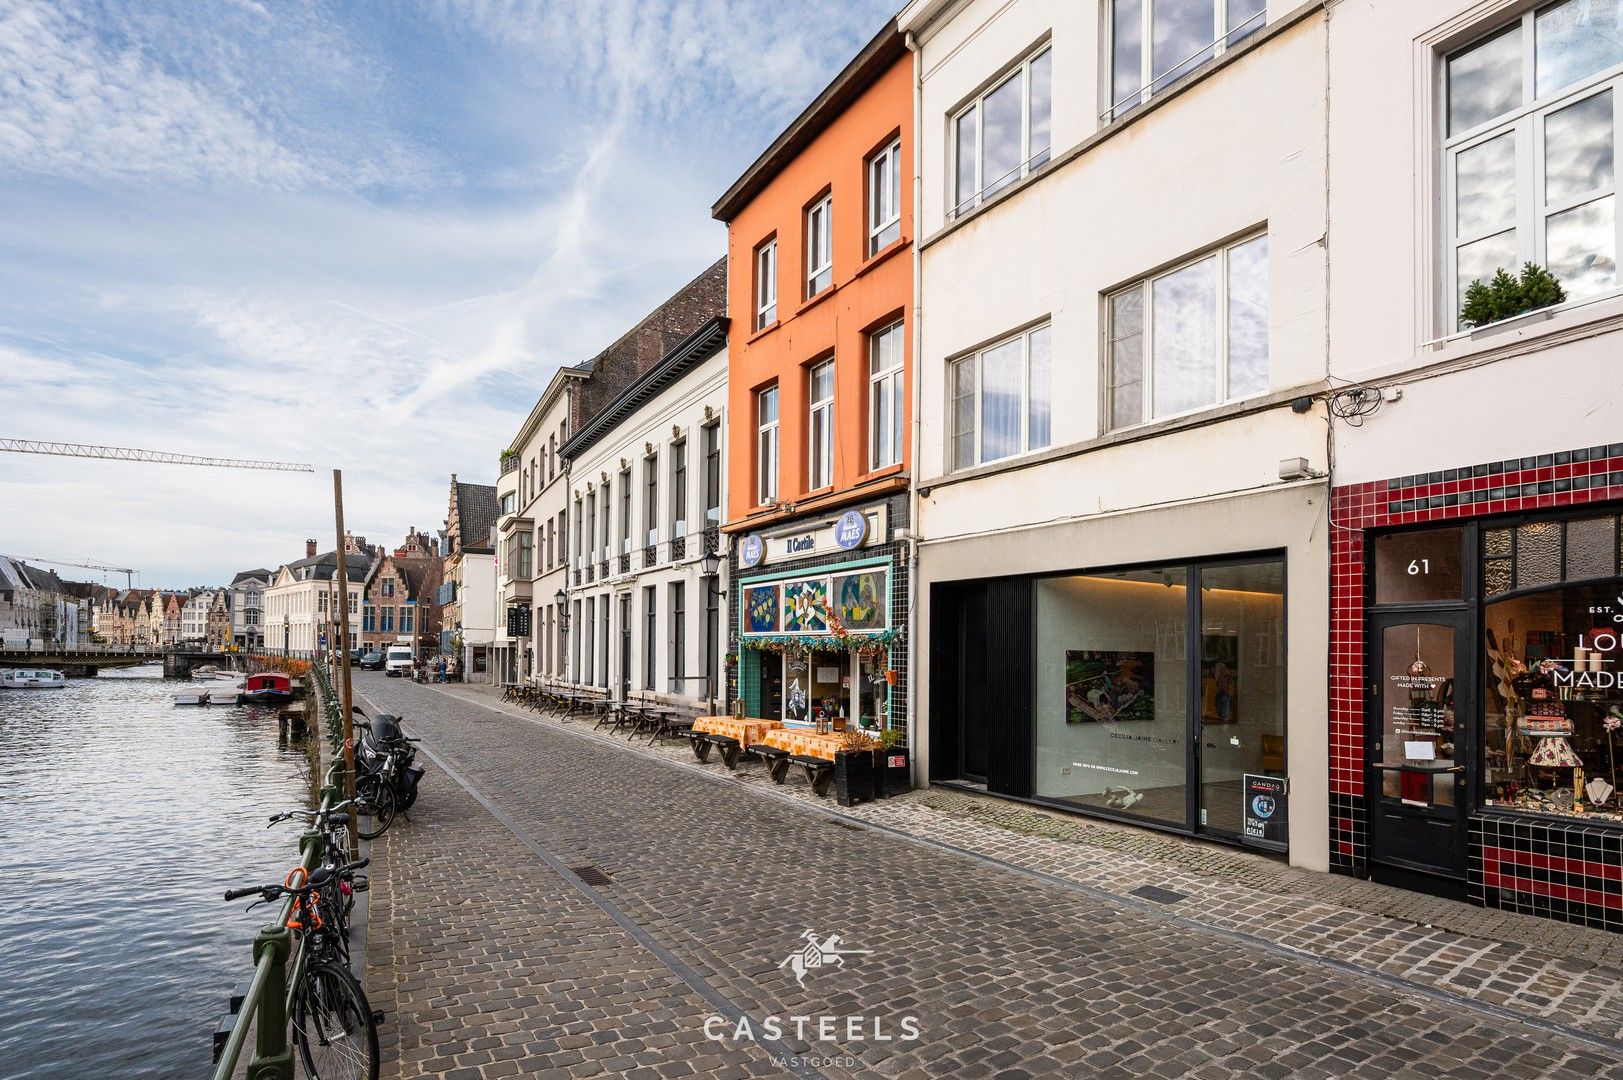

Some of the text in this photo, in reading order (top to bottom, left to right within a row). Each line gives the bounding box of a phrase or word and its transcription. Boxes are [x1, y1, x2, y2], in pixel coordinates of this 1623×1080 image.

[839, 527, 860, 542] MAES
[786, 534, 815, 553] Il Cortile
[745, 548, 759, 561] MAES
[1407, 559, 1429, 575] 61
[1589, 606, 1615, 614] EST.
[1578, 633, 1623, 652] LO
[1110, 732, 1133, 741] CECILIA
